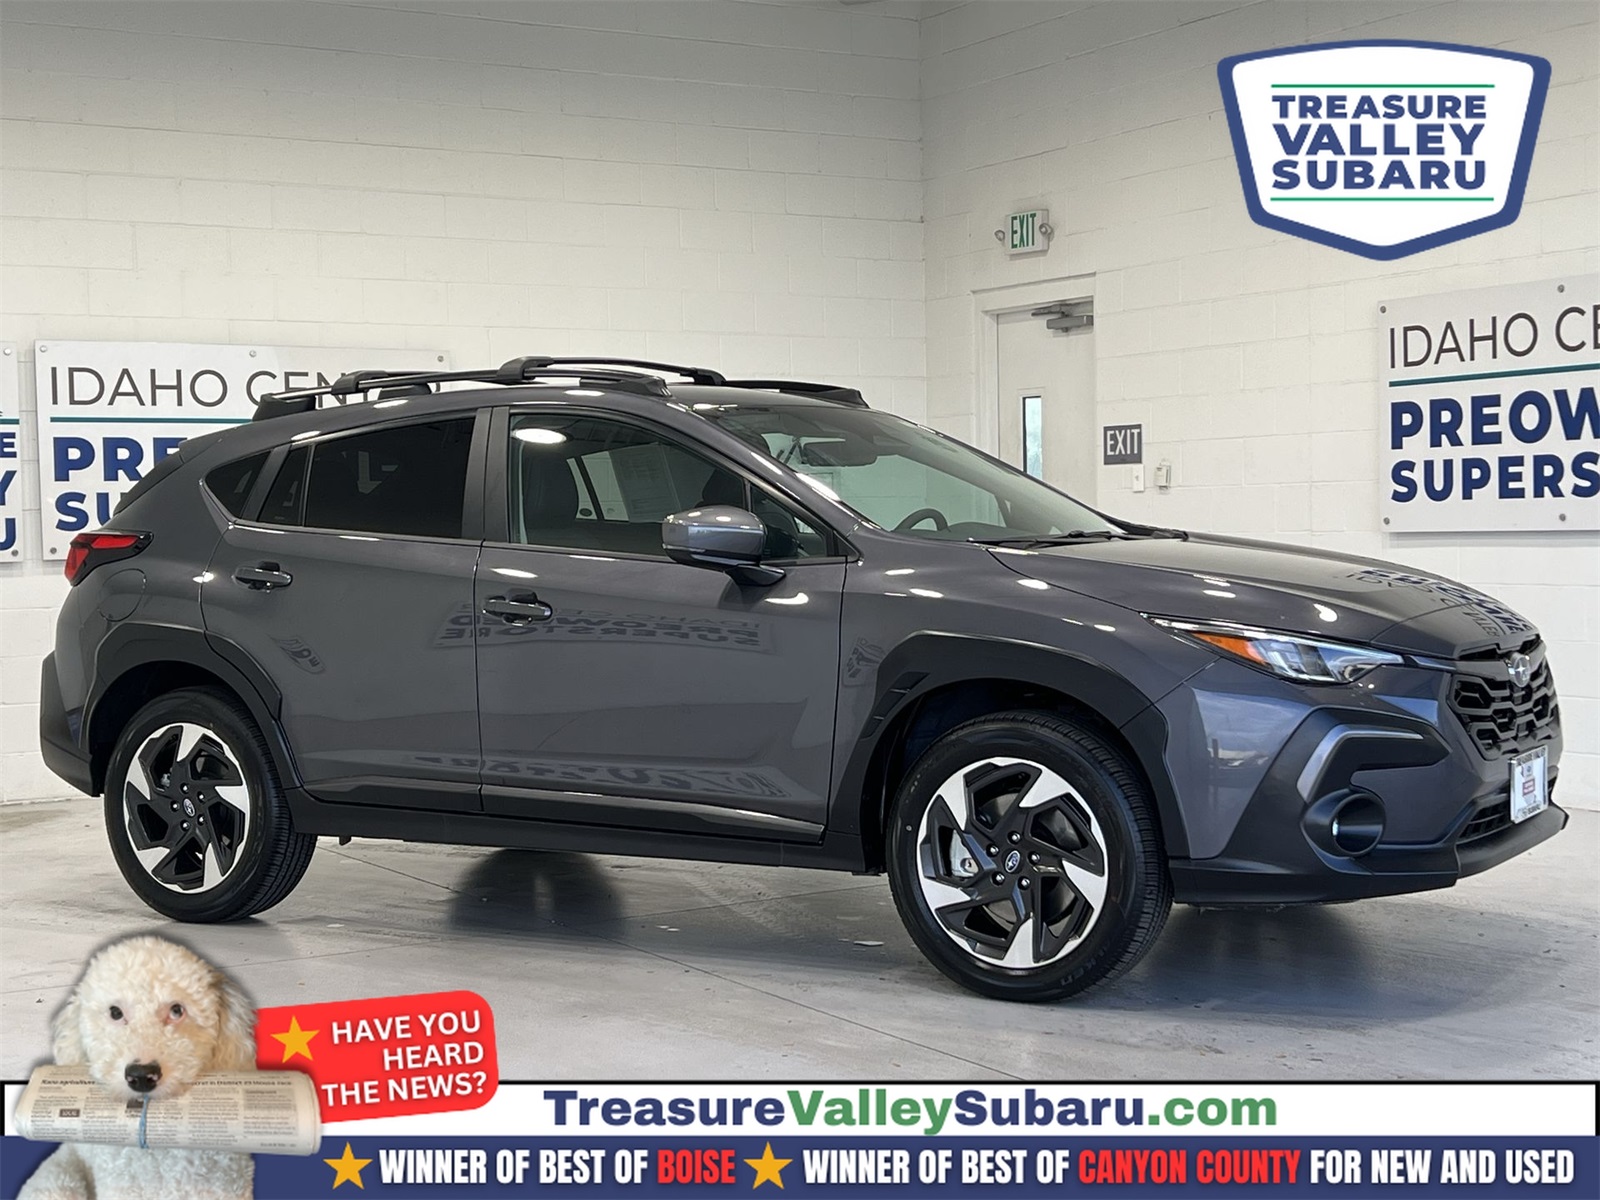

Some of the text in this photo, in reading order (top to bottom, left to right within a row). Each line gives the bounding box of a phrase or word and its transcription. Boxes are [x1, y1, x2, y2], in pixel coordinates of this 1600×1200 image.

[1010, 212, 1037, 250] EXIT
[1389, 311, 1539, 369] IDAHO
[50, 366, 229, 408] IDAHO
[1390, 386, 1600, 450] PREOW
[1106, 428, 1141, 456] EXIT
[1390, 451, 1600, 503] SUPERS
